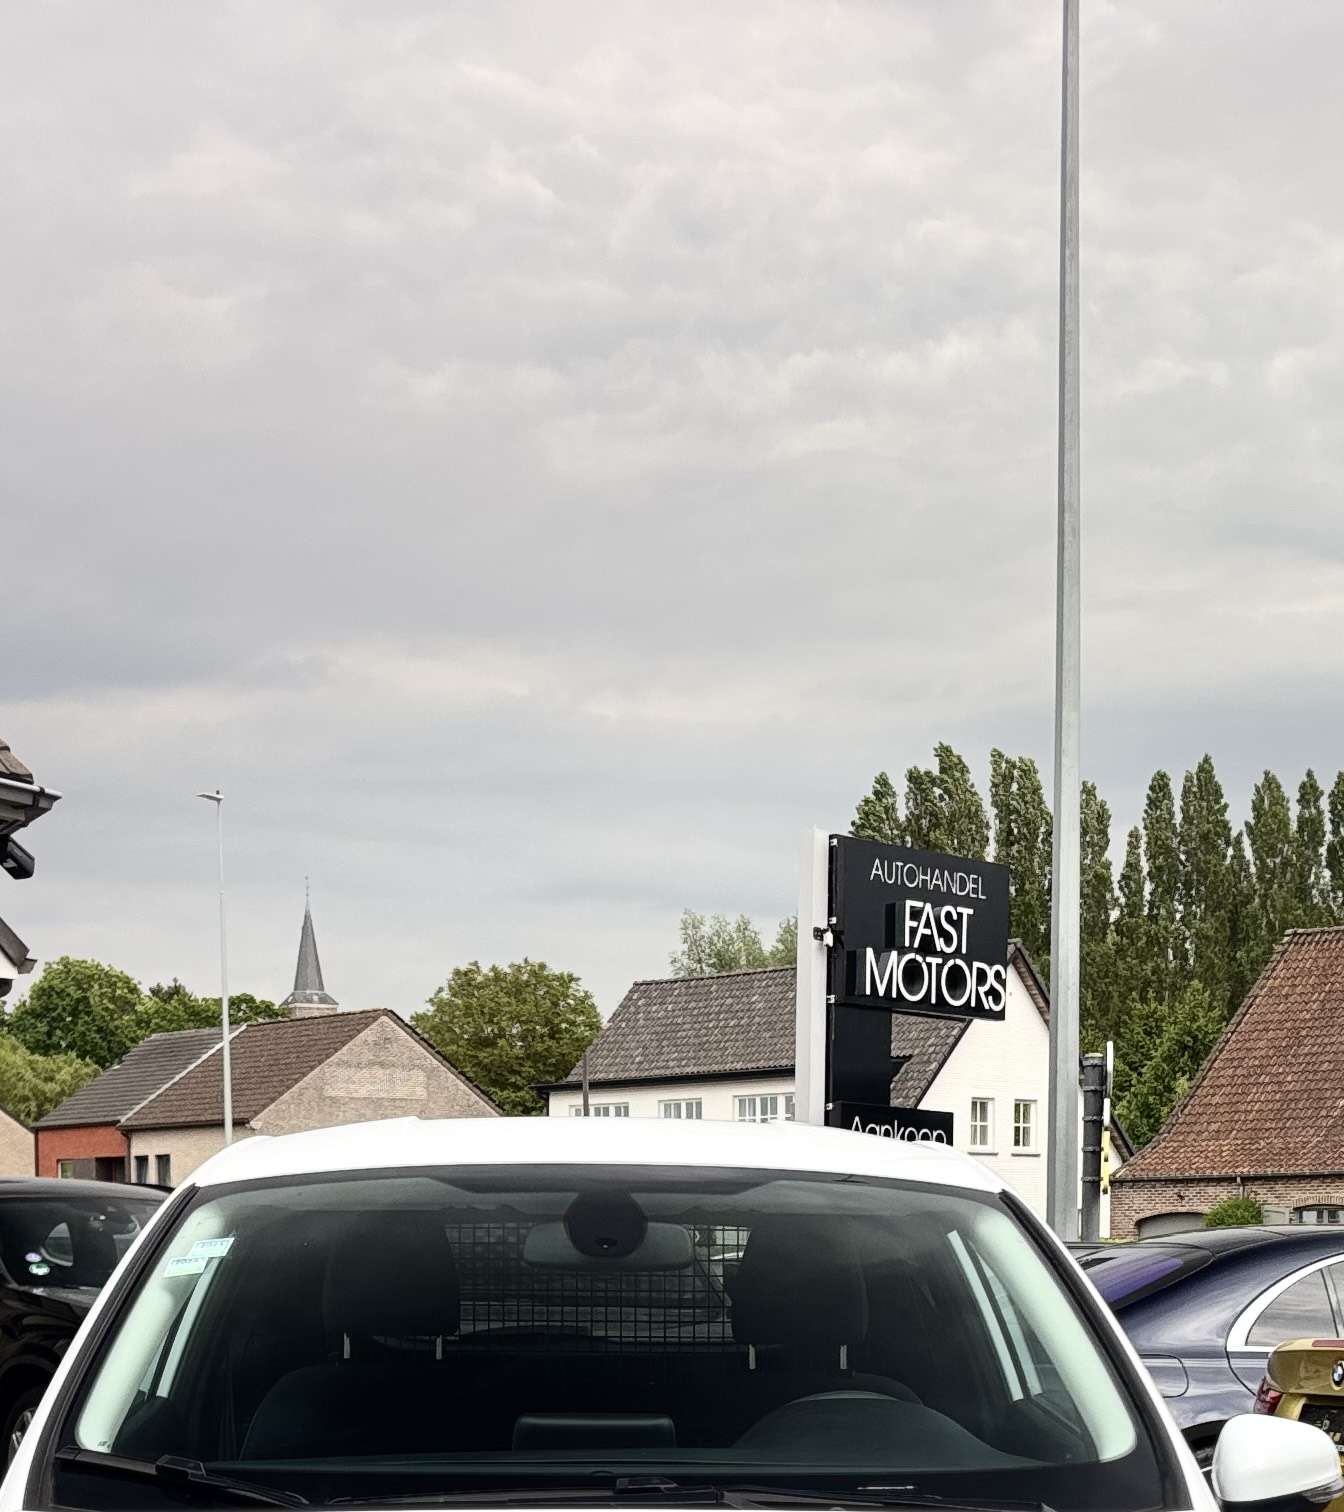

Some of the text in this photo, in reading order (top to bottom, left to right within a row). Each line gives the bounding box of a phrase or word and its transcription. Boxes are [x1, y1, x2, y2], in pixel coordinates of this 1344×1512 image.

[870, 857, 987, 899] AUTOHANDEL
[905, 899, 974, 954] FAST
[865, 947, 1006, 1012] MOTORS
